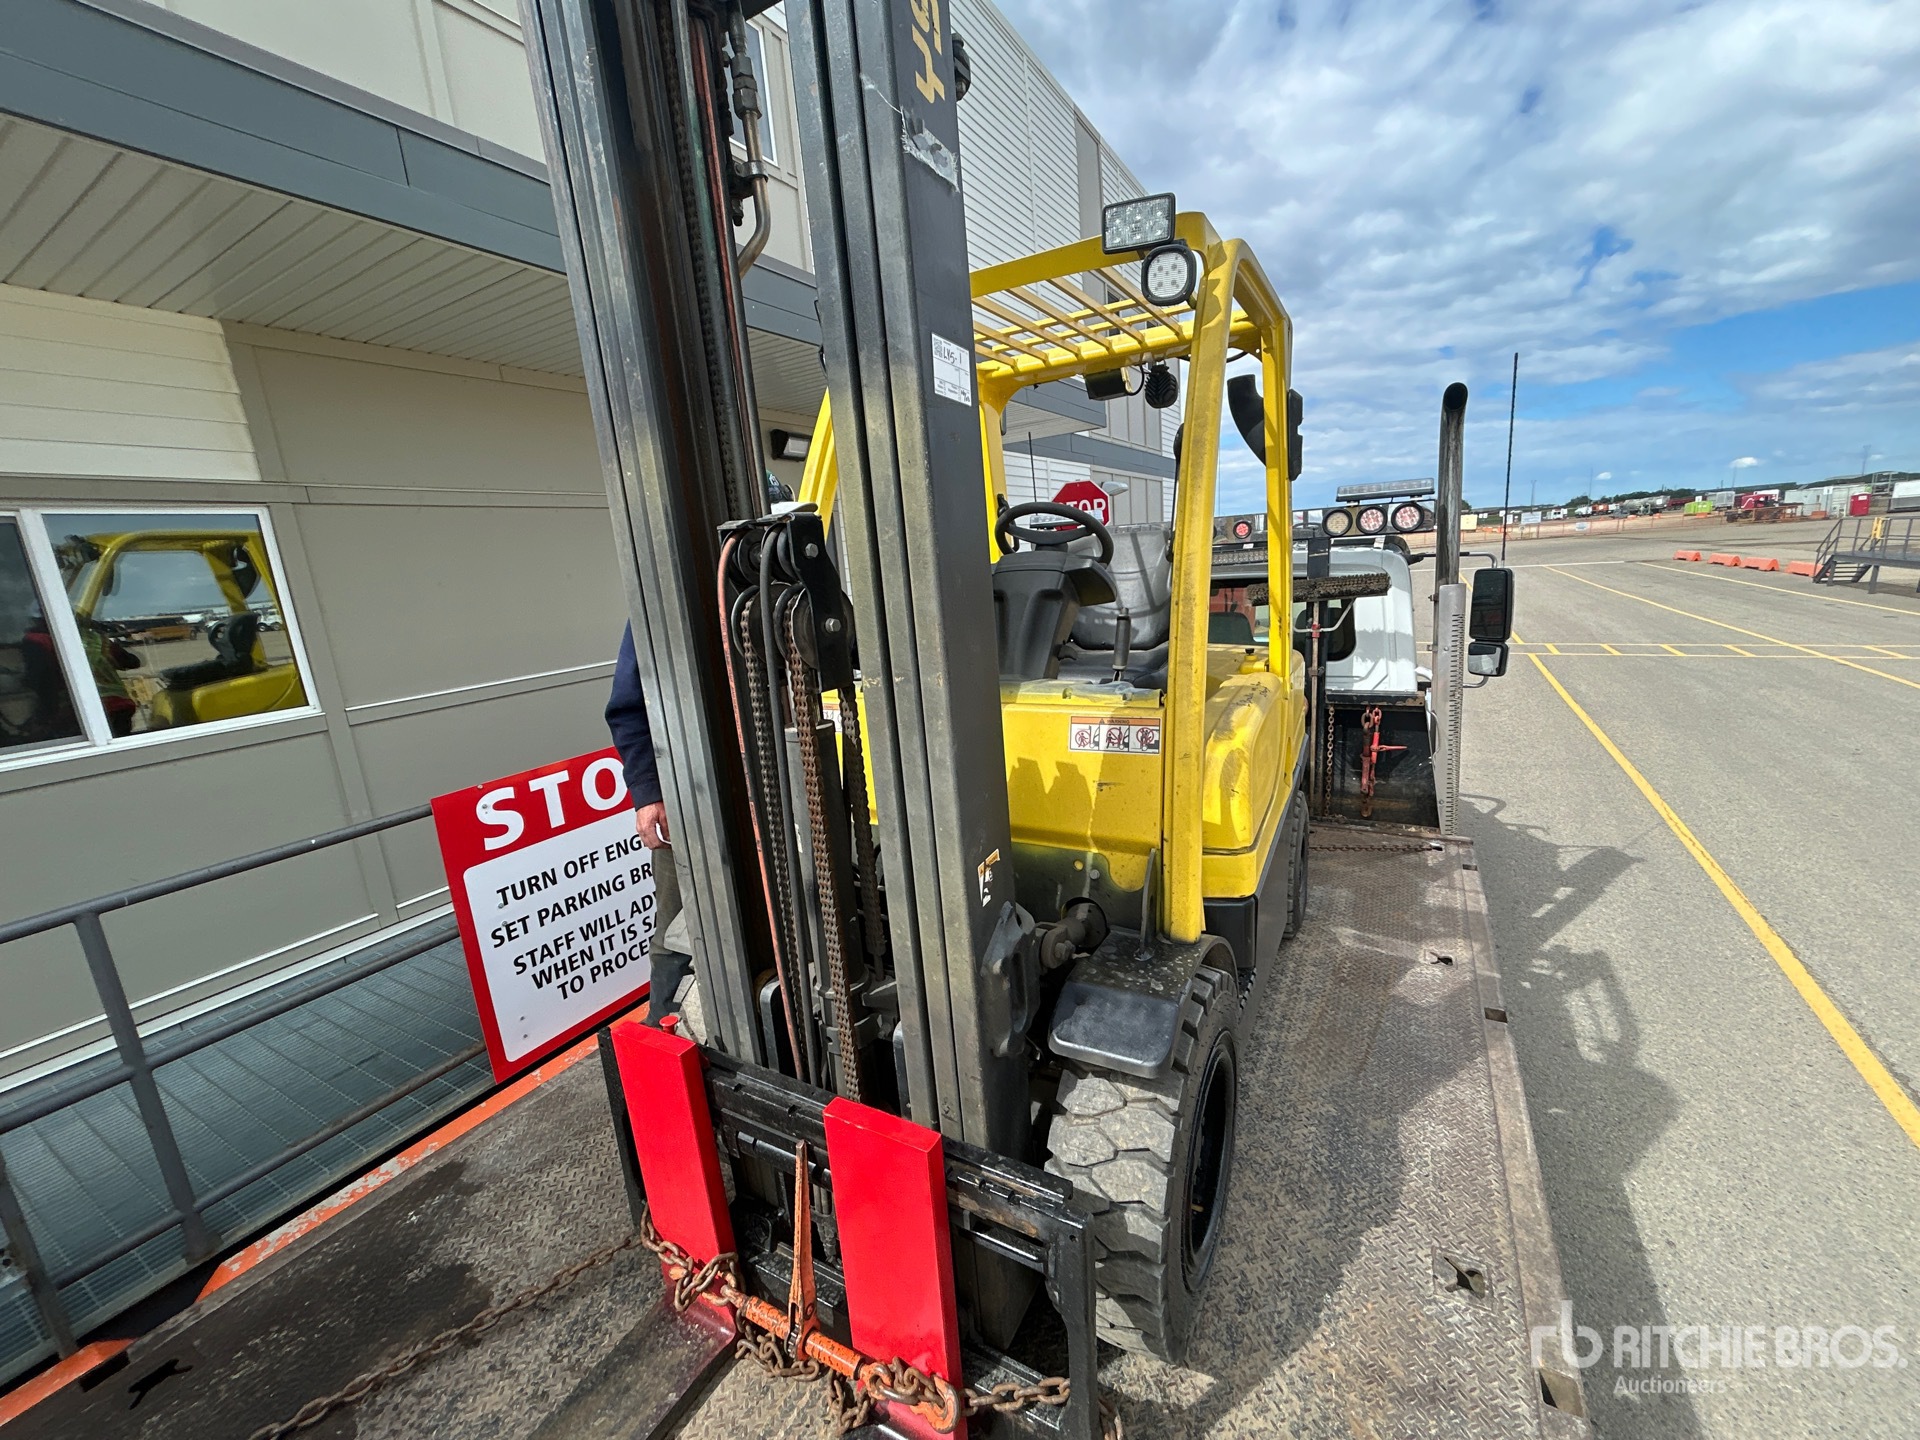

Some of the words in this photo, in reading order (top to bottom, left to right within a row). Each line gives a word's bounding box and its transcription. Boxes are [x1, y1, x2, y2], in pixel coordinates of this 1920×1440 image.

[475, 757, 628, 851] STO
[490, 915, 530, 949] SET
[537, 874, 626, 928] PARKING
[629, 862, 652, 885] BR
[496, 867, 558, 907] TURN
[563, 851, 601, 879] OFF
[605, 834, 646, 863] ENG
[513, 931, 576, 976] STAFF
[579, 909, 626, 942] WILL
[531, 945, 595, 990] WHEN
[599, 933, 615, 956] IT
[620, 923, 638, 945] IS
[557, 975, 584, 1000] TO
[589, 935, 654, 984] PROCE
